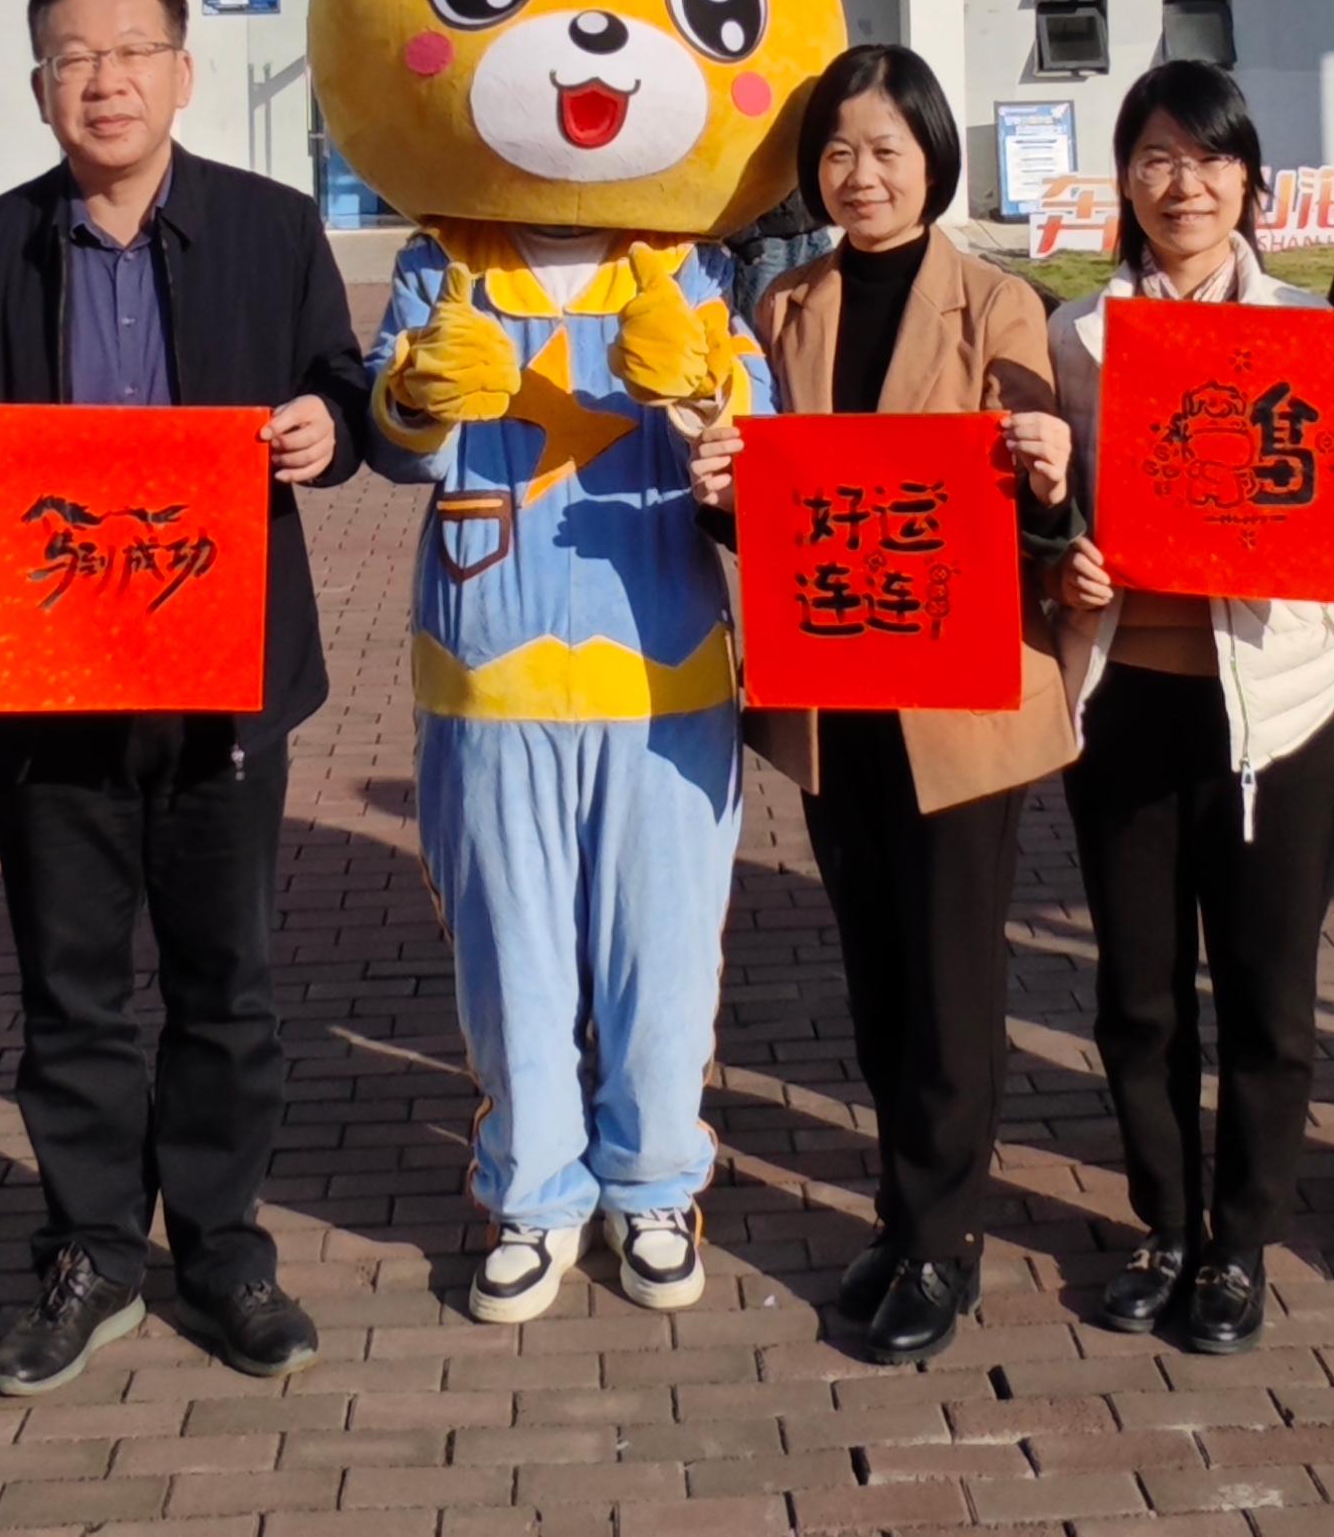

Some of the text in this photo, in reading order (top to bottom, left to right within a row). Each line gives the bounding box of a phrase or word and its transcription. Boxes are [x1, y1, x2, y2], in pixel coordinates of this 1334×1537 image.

[792, 480, 948, 552] 好运
[28, 528, 218, 615] 马到成功
[794, 561, 921, 635] 连连
